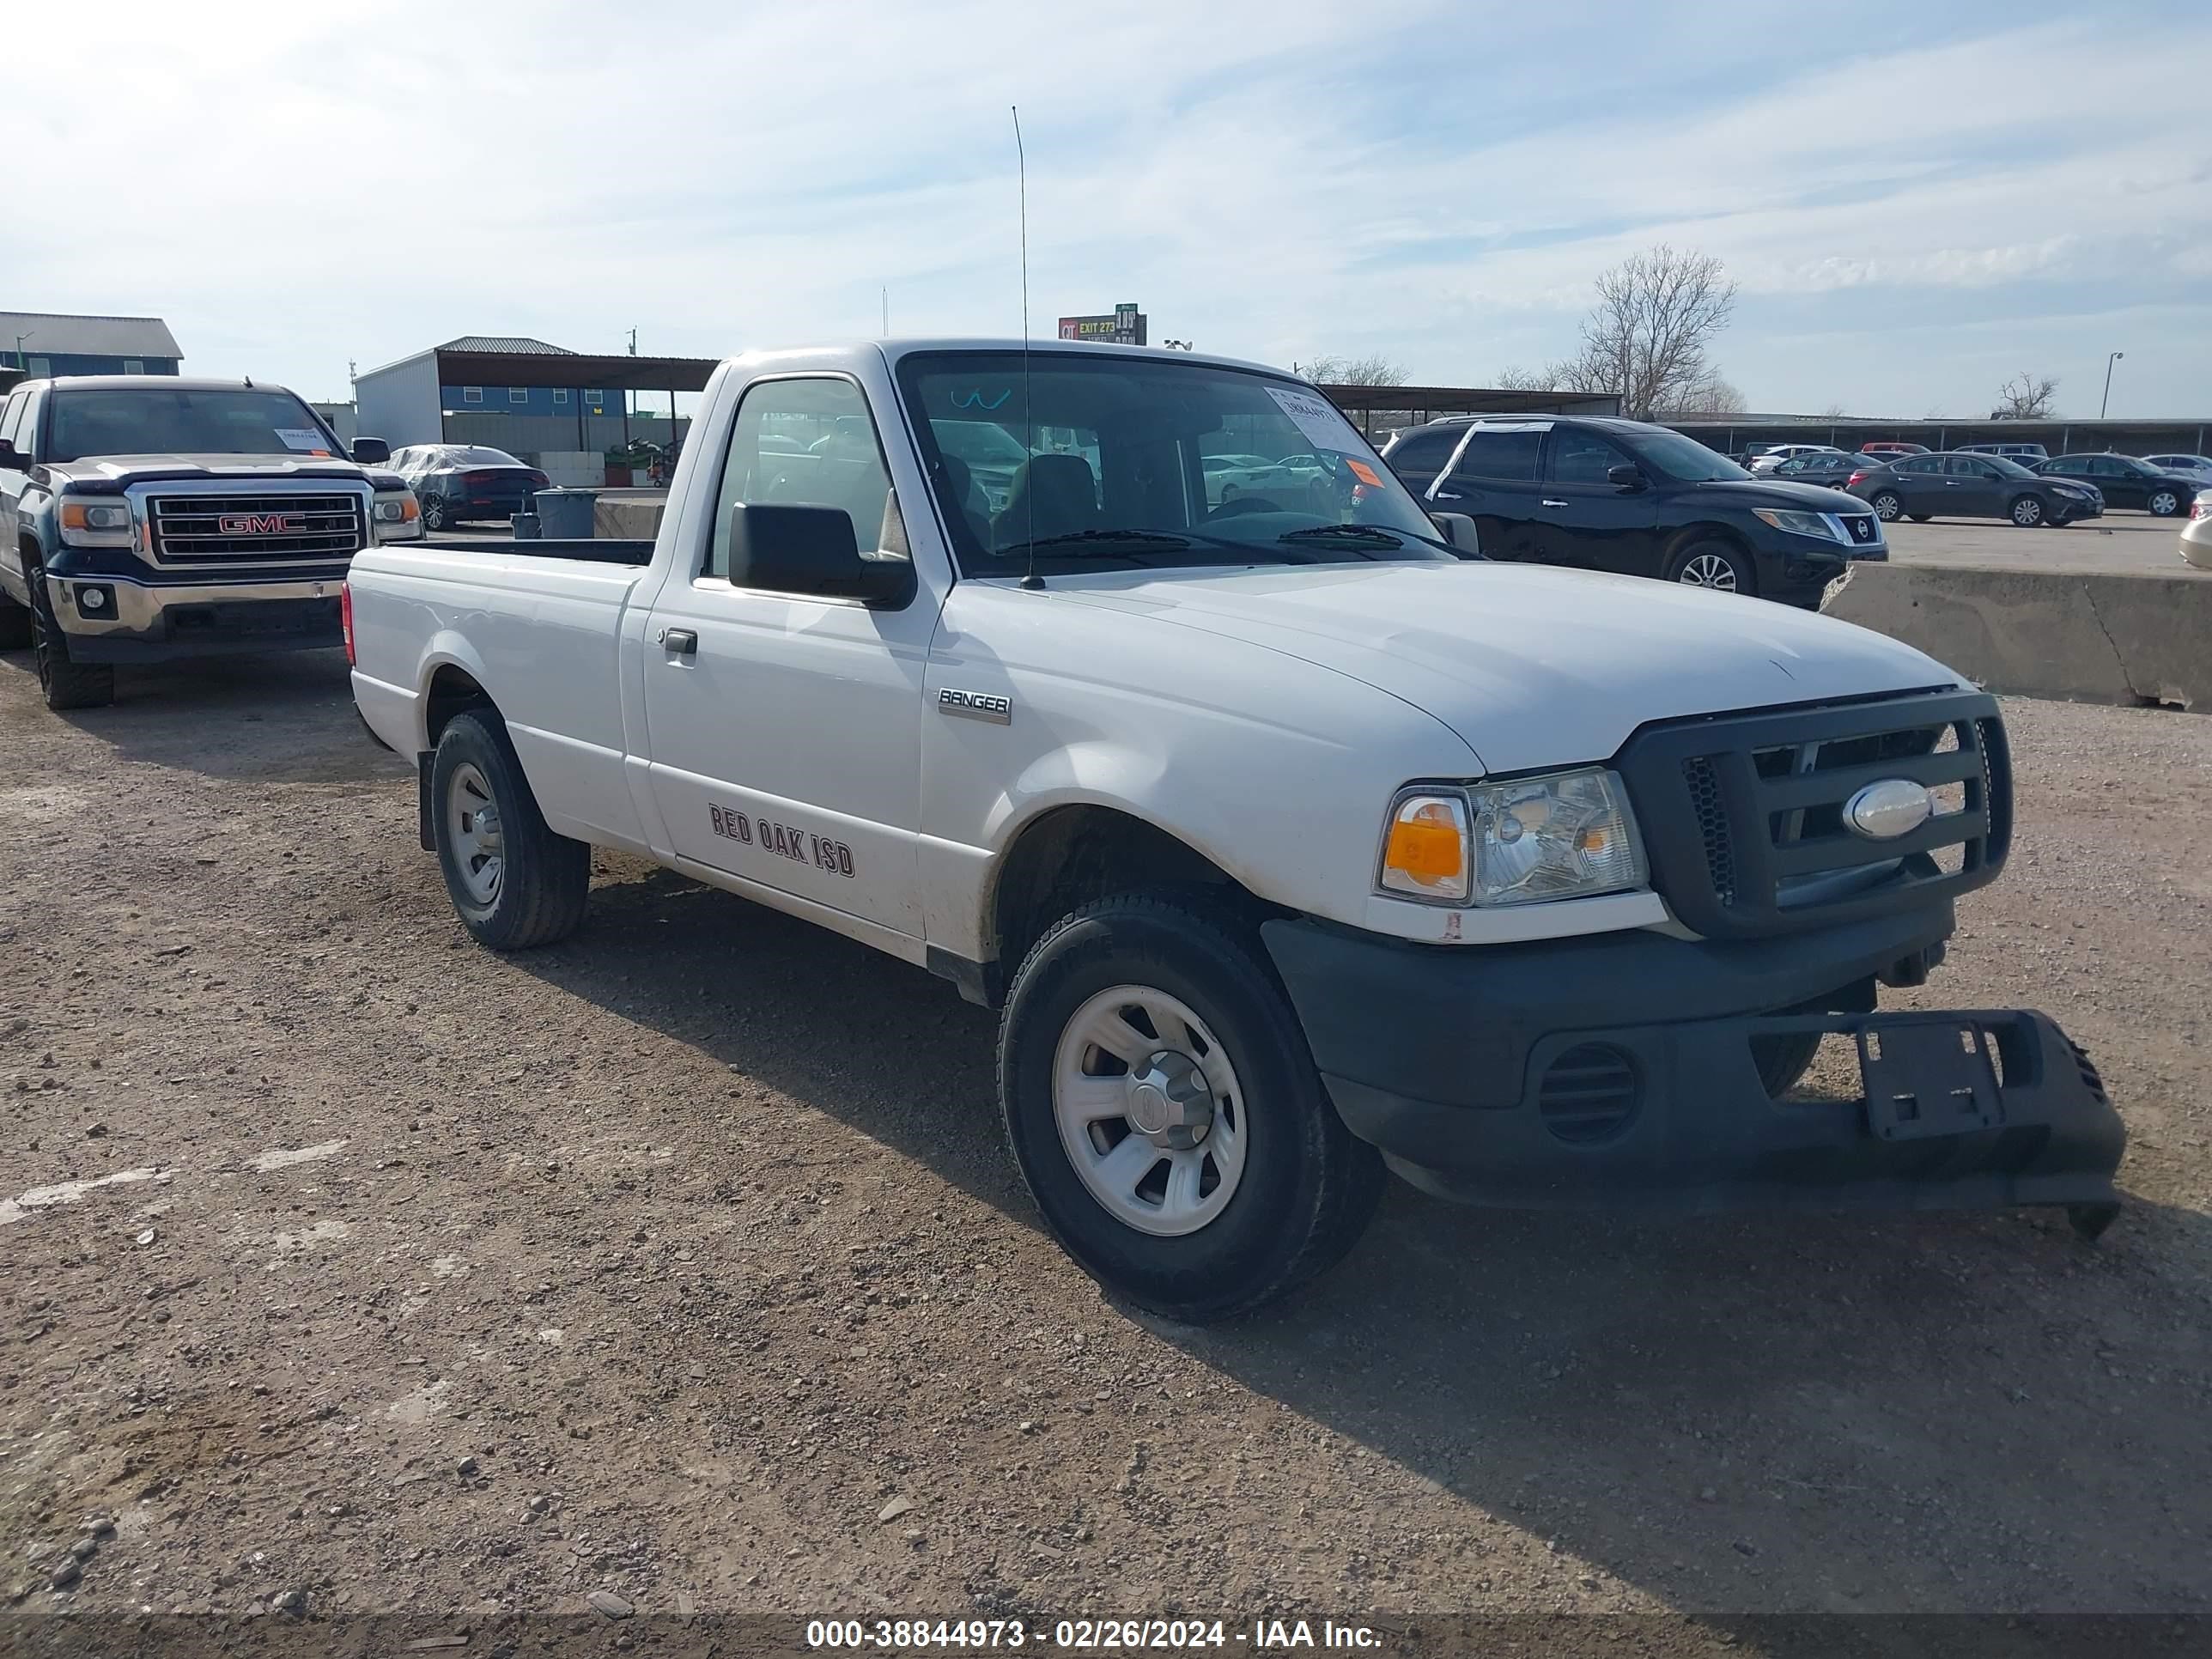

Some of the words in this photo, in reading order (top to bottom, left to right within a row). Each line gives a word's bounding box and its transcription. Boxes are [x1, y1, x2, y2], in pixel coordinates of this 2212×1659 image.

[1061, 325, 1075, 340] QT
[1079, 323, 1098, 334] EXIT
[1100, 322, 1115, 333] 273
[219, 514, 307, 534] GMC
[939, 689, 1009, 714] RANGER
[708, 803, 753, 846] RED
[757, 818, 809, 865] OAK
[811, 834, 855, 878] ISD
